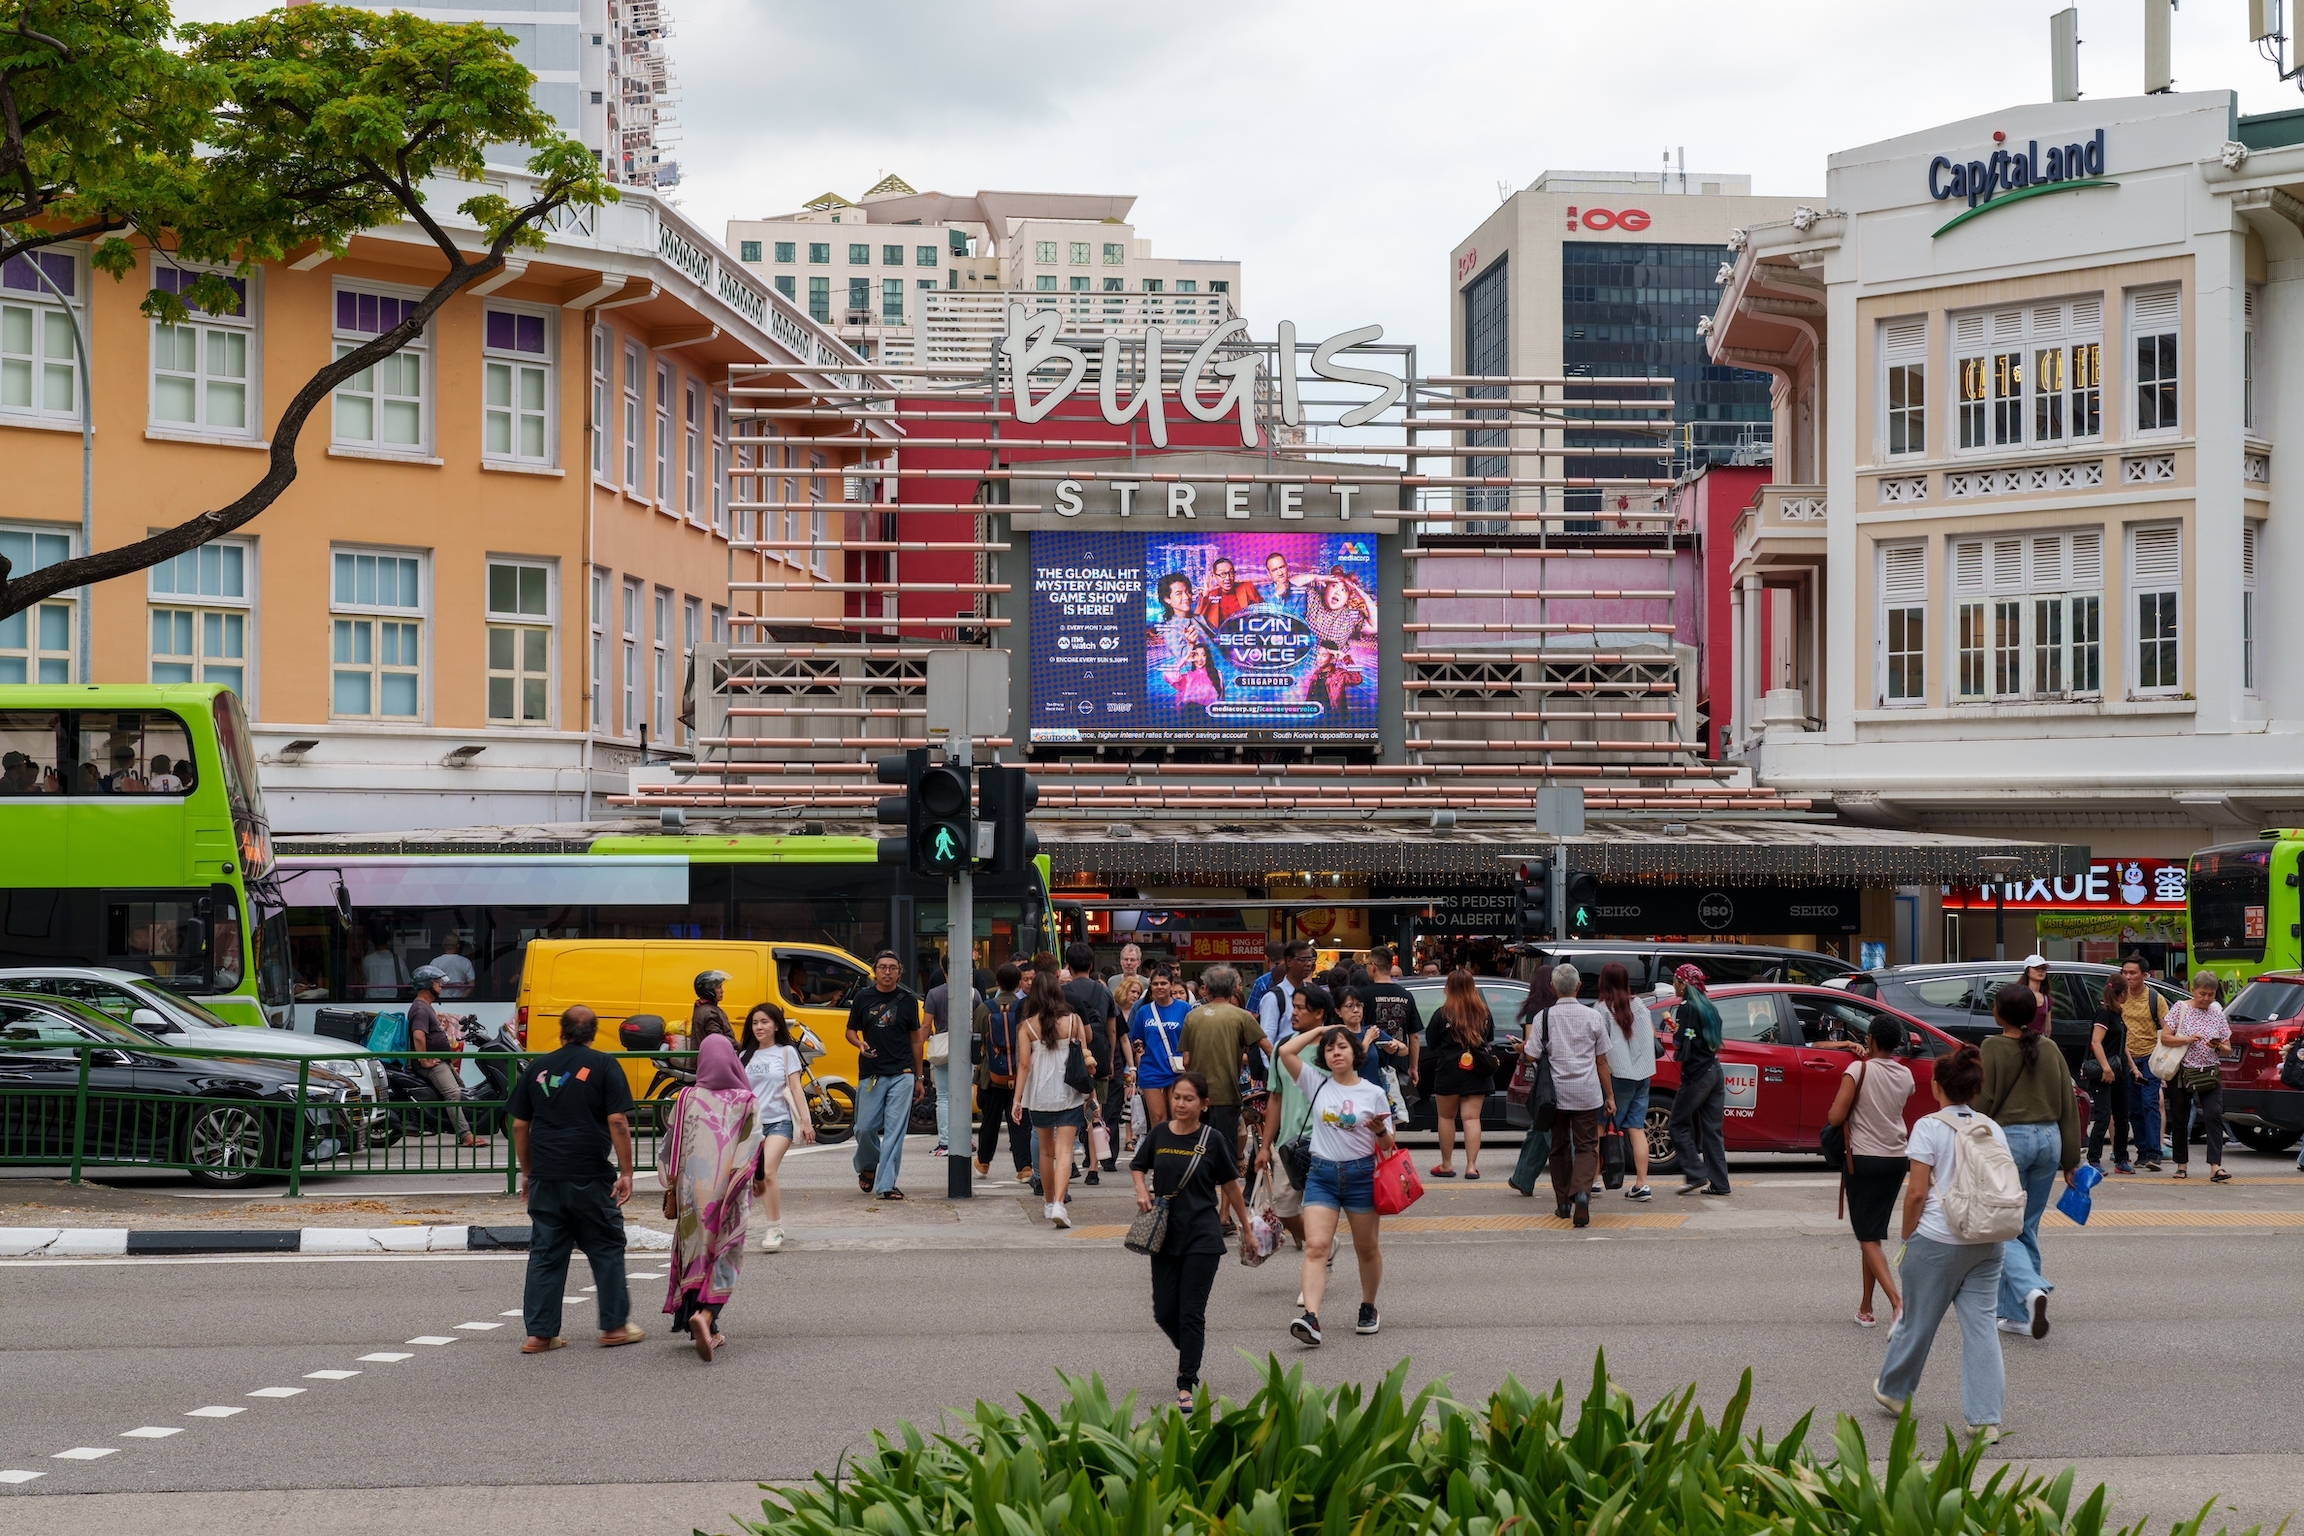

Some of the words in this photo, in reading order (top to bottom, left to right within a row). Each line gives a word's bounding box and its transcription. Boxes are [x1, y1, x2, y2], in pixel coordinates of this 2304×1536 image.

[1928, 128, 2104, 208] CapitaLand
[1582, 208, 1651, 232] OG
[1000, 302, 1404, 449] BUGIS
[1054, 479, 1361, 522] STREET
[1338, 554, 1370, 562] mediacorp
[1037, 568, 1063, 579] THE
[1065, 568, 1116, 579] GLOBAL
[1118, 568, 1140, 579] HIT
[1036, 580, 1093, 591] MYSTERY
[1095, 580, 1142, 591] SINGER
[1049, 592, 1086, 603] GAME
[1088, 592, 1128, 603] SHOW
[1063, 604, 1075, 615] IS
[1077, 604, 1114, 615] HERE!
[1239, 618, 1243, 632] I
[1248, 618, 1292, 632] CAN
[1220, 634, 1256, 646] SEE
[1259, 634, 1309, 646] YOUR
[1071, 642, 1096, 650] watch
[1234, 648, 1295, 662] VOICE
[1241, 678, 1289, 686] SINGAPORE
[1212, 706, 1318, 714] mediacorp.sg/icanseeyourvoice
[1098, 731, 1120, 740] higher
[1120, 731, 1145, 739] interest
[1146, 731, 1162, 739] rates
[1163, 731, 1174, 739] for
[1174, 731, 1195, 739] senior
[1196, 732, 1220, 740] savings
[1319, 732, 1354, 740] opposition
[1354, 732, 1369, 740] says
[1595, 906, 1642, 917] SEIKO
[1702, 905, 1729, 917] BSO
[1790, 905, 1839, 917] SEIKO
[1450, 914, 1502, 925] ALBERT
[2044, 918, 2063, 928] TASTE
[2063, 917, 2090, 926] MATCHA
[2090, 914, 2118, 924] CLASSICS
[2062, 928, 2083, 939] ENJOY
[2083, 924, 2096, 934] THE
[2096, 920, 2120, 932] NATURE
[1232, 938, 1250, 946] KING
[1252, 938, 1264, 946] OF
[1232, 946, 1264, 955] BRAISE
[1725, 1076, 1755, 1087] MILE
[1736, 1110, 1754, 1118] NOW
